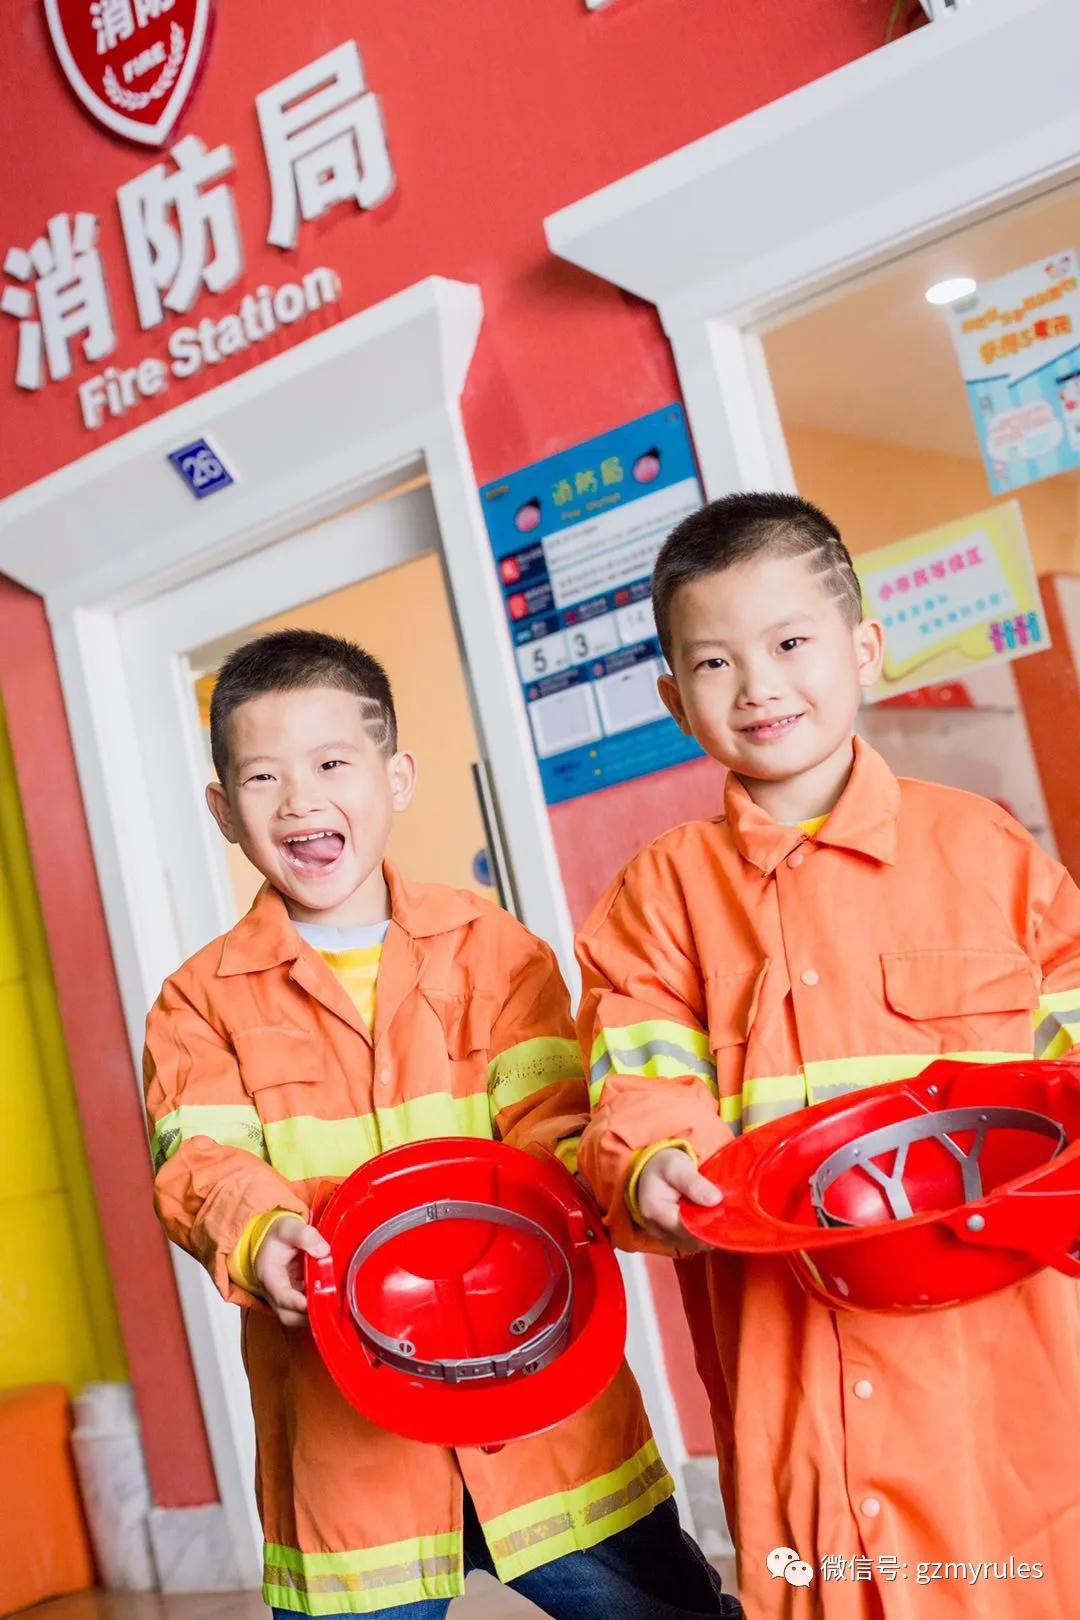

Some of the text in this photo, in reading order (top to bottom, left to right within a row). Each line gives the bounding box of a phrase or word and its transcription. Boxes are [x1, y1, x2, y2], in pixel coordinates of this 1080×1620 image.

[122, 40, 167, 84] FIRE
[1, 38, 397, 391] 消防局
[78, 266, 341, 430] Fire Station
[181, 449, 223, 488] 26
[532, 648, 548, 673] 5
[573, 632, 589, 658] 3
